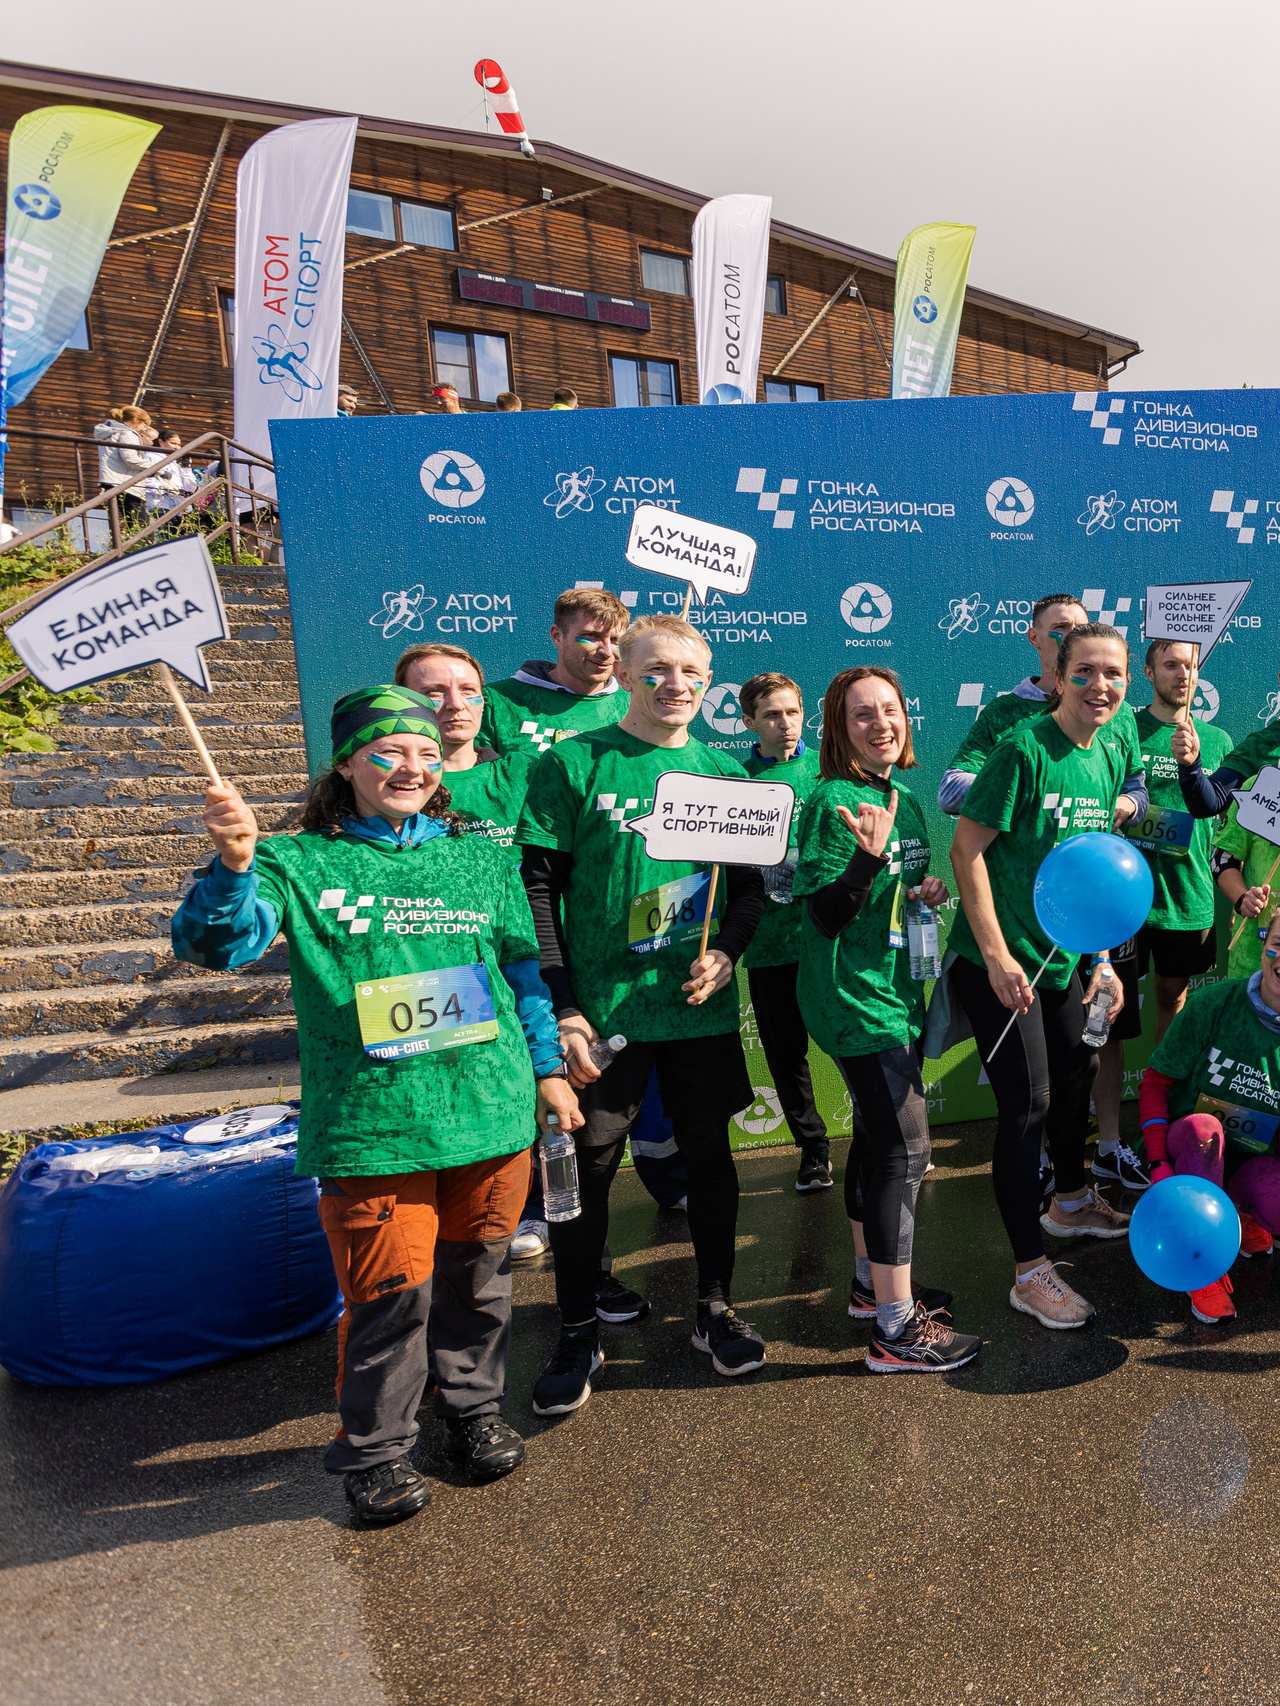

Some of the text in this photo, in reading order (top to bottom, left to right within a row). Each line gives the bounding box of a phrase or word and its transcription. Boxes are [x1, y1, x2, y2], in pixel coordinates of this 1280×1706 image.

[39, 131, 75, 183] РОСАТОМ
[263, 235, 290, 315] АТОМ
[924, 246, 936, 293] РОСАТОМ
[294, 232, 322, 328] СПОРТ
[723, 263, 741, 375] РОСАТОМ
[1132, 400, 1194, 418] ГОНКА
[1133, 418, 1258, 438] ДИВИЗИОНОВ
[1134, 434, 1230, 452] РОСАТОМА
[613, 476, 675, 495] АТОМ
[807, 480, 880, 497] ГОНКА
[808, 498, 956, 518] ДИВИЗИОНОВ
[1130, 498, 1178, 515] АТОМ
[428, 513, 487, 525] РОСАТОМ
[810, 516, 923, 534] РОСАТОМА
[1123, 517, 1182, 533] СПОРТ
[650, 525, 736, 560] ЛУЧШАЯ
[990, 532, 1034, 541] РОСАТОМ
[636, 536, 743, 578] КОМАНДА!
[445, 593, 511, 611] АТОМ
[1165, 591, 1216, 602] СИЛЬНЕЕ
[49, 577, 179, 642] ЕДИНАЯ
[1158, 602, 1211, 612] РОСАТОМ
[436, 615, 518, 633] СПОРТ
[988, 619, 1033, 634] СПО
[1164, 613, 1216, 622] СИЛЬНЕЕ
[52, 600, 203, 670] КОМАНДА
[701, 629, 773, 643] АТОМА
[1166, 623, 1213, 633] РОССИЯ!
[845, 638, 893, 648] РОСАТОМ
[1153, 755, 1178, 764] ГОНК
[1075, 797, 1100, 808] ГОНКА
[661, 802, 674, 815] Я
[684, 803, 718, 818] ТУТ
[727, 806, 780, 823] САМЫЙ
[1266, 816, 1276, 827] А
[662, 818, 775, 837] СПОРТИВНЫЙ!
[1142, 818, 1179, 842] 056
[381, 896, 445, 908] ГОНКА
[382, 909, 490, 925] ДИВИЗИОНО
[647, 897, 696, 933] 048
[384, 922, 481, 935] РОСАТОМА
[390, 992, 465, 1033] 054
[1236, 1062, 1271, 1084] ГОНКА
[738, 1137, 786, 1150] РОСАТОМ
